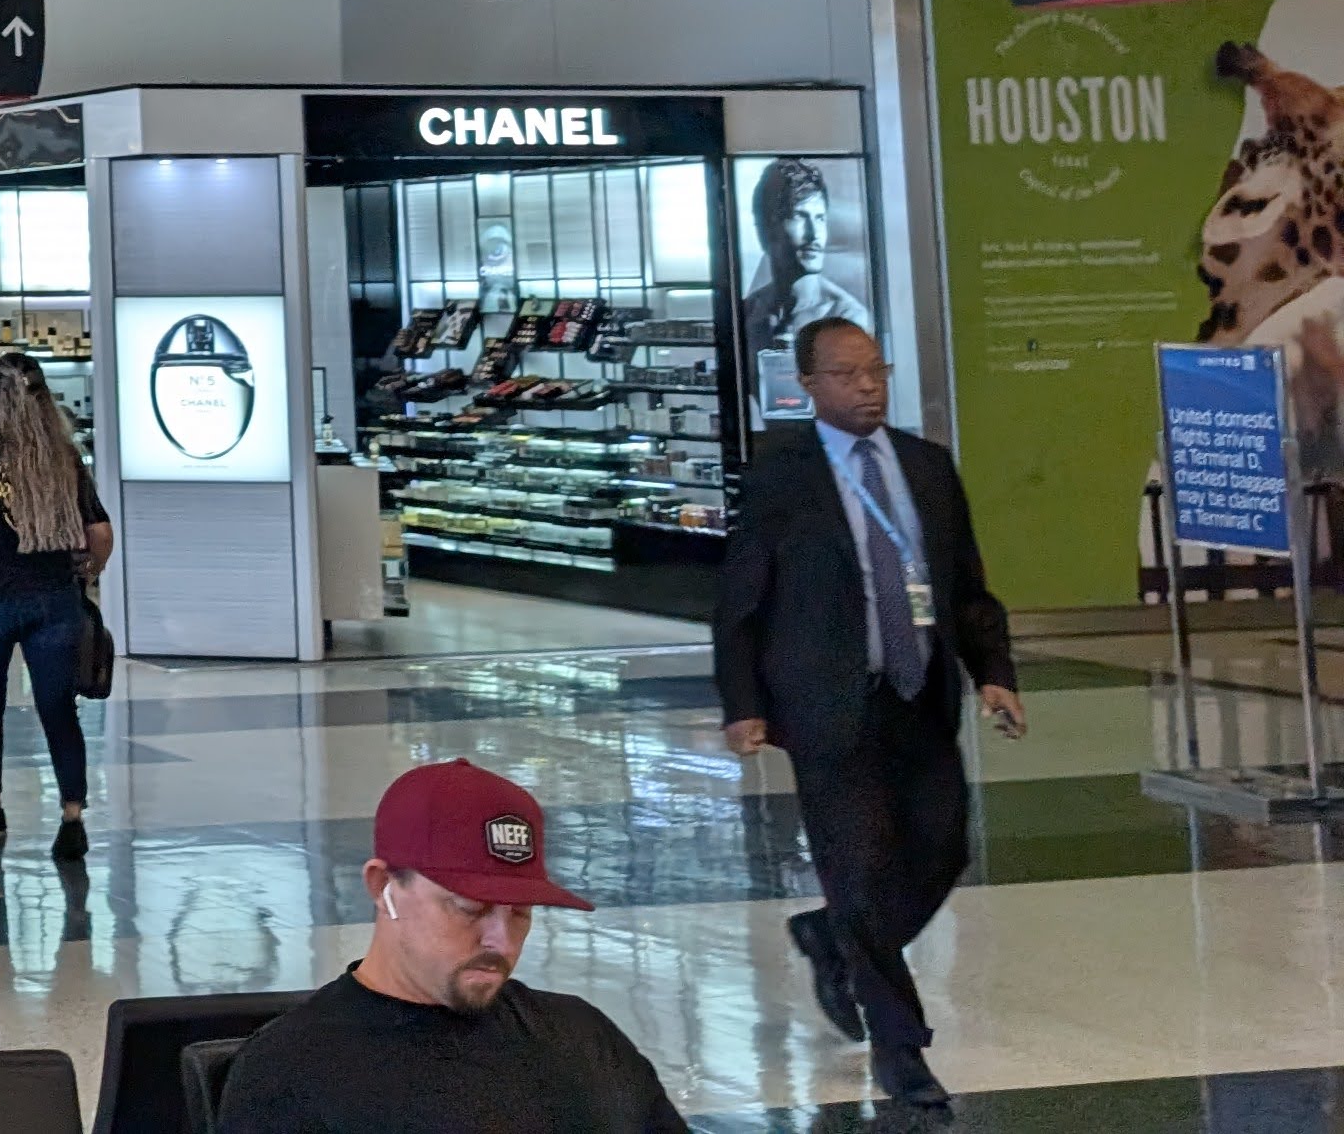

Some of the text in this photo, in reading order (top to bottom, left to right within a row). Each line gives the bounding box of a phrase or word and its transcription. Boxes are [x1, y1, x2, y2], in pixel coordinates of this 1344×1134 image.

[966, 74, 1167, 145] HOUSTON
[418, 106, 620, 147] CHANEL
[1169, 407, 1276, 430] United domestic
[1213, 430, 1267, 452] arriving
[1173, 449, 1188, 464] at
[1188, 448, 1244, 468] Terminal
[1174, 470, 1287, 495] checked baggage
[1176, 489, 1281, 513] may be claimed
[1179, 508, 1265, 531] at Terminal C
[491, 823, 529, 846] NEFF
